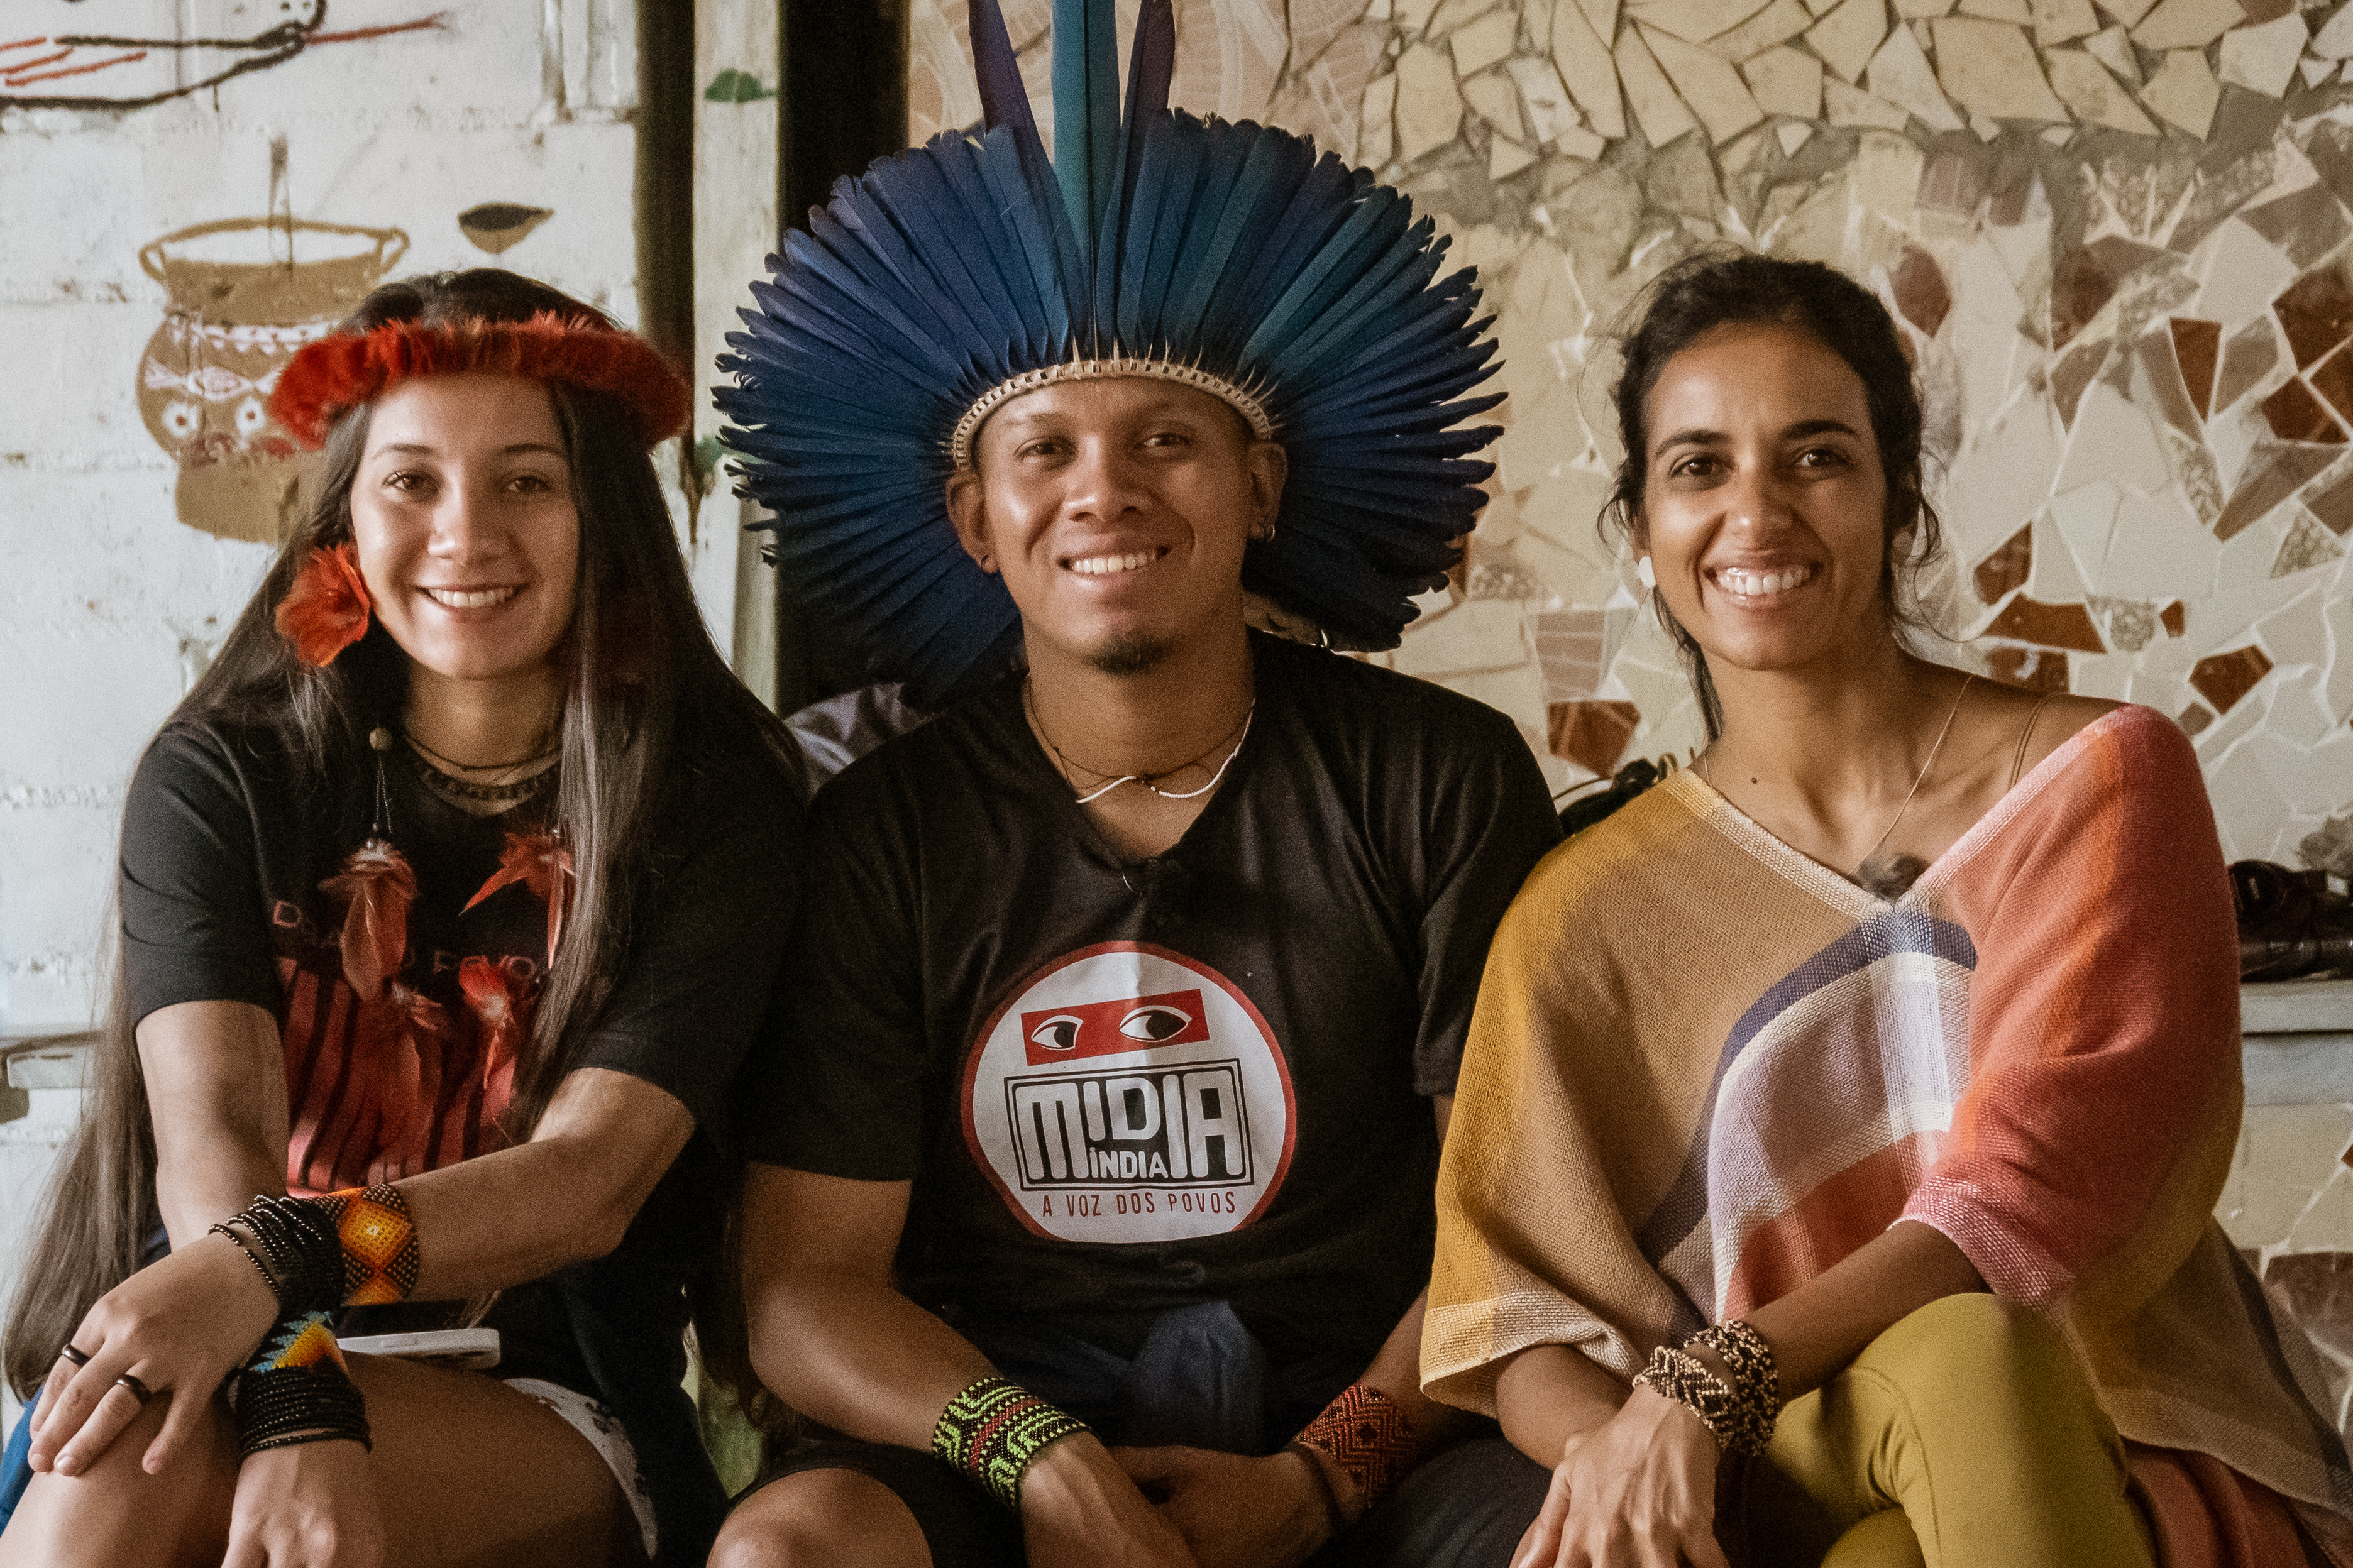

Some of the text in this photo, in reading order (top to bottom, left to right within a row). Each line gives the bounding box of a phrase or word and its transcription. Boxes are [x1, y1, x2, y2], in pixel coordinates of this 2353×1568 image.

[1042, 1191, 1235, 1217] A VOZ DOS POVOS
